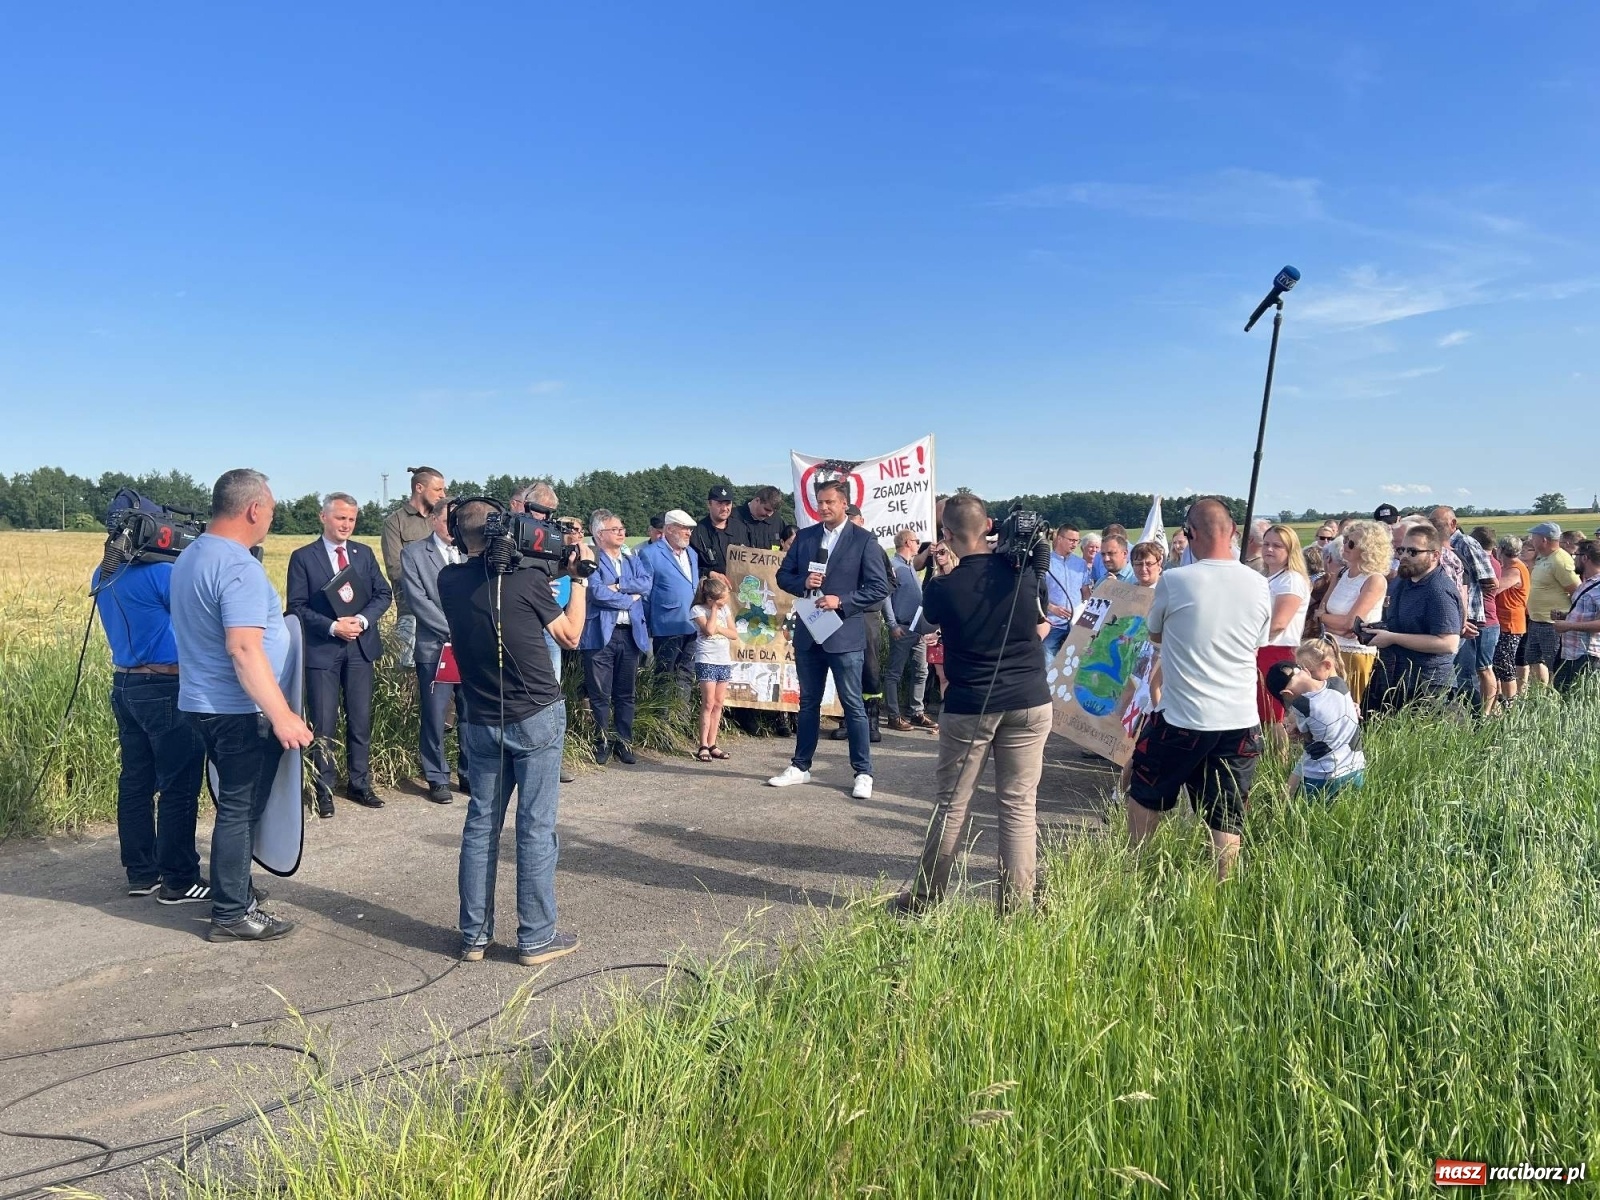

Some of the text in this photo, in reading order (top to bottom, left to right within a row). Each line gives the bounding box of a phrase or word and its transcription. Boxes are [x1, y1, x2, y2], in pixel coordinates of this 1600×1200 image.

[879, 456, 910, 480] NIE
[872, 480, 929, 499] ZGADZAMY
[888, 500, 909, 514] SIĘ
[157, 527, 172, 548] 3
[533, 528, 545, 552] 2
[730, 550, 747, 562] NIE
[737, 649, 796, 661] NIE DLA A
